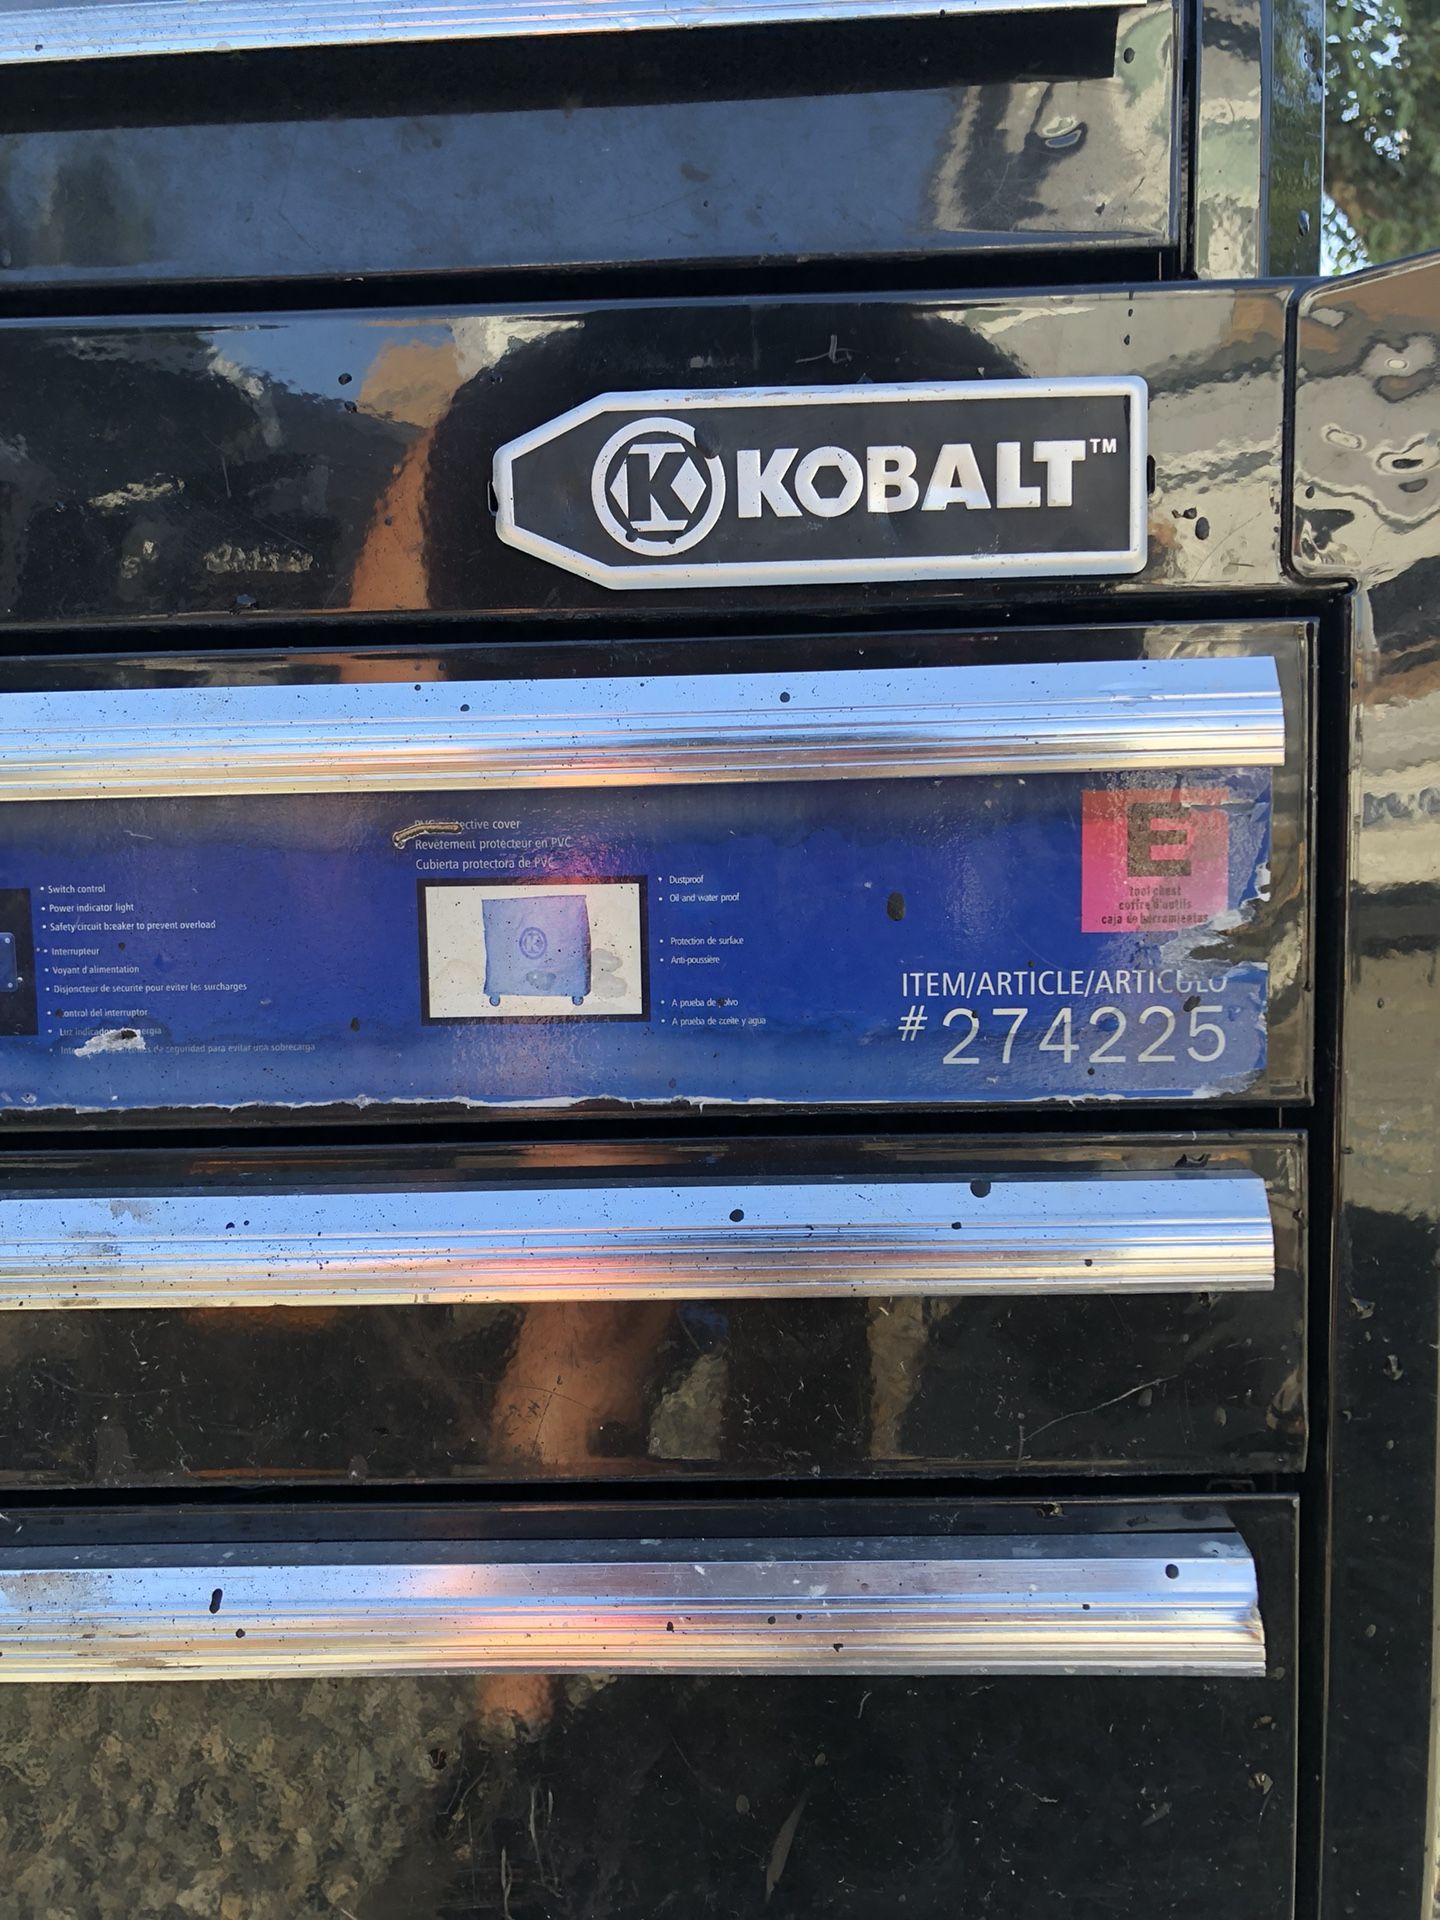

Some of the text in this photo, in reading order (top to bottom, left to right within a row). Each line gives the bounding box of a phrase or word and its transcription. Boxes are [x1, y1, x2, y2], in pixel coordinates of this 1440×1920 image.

[736, 439, 1087, 519] KOBALT
[437, 819, 489, 832] ective
[492, 820, 521, 829] cover
[479, 838, 533, 851] protecteur
[535, 840, 547, 848] en
[551, 837, 571, 848] PVC
[1127, 802, 1192, 877] E
[415, 856, 554, 871] Cubierta protectora de PVC
[669, 874, 704, 886] Dustproof
[48, 884, 106, 894] Switch control
[669, 892, 740, 903] Oil and water proof
[49, 902, 135, 913] Power indicator light
[50, 919, 216, 933] Safety circuit breaker to prevent overload
[1101, 914, 1123, 926] caja
[670, 935, 744, 946] Protection de surface
[51, 947, 100, 957] Interrupteur
[52, 965, 80, 976] Voyant
[53, 983, 99, 995] Disjoncteur
[100, 983, 110, 993] de
[145, 983, 165, 995] pour
[203, 981, 247, 994] surcharges
[671, 997, 739, 1009] A prueba de olvo
[56, 1008, 149, 1020] ontrol del interruptor
[671, 1017, 678, 1026] A
[680, 1017, 705, 1028] prueba
[707, 1016, 717, 1026] de
